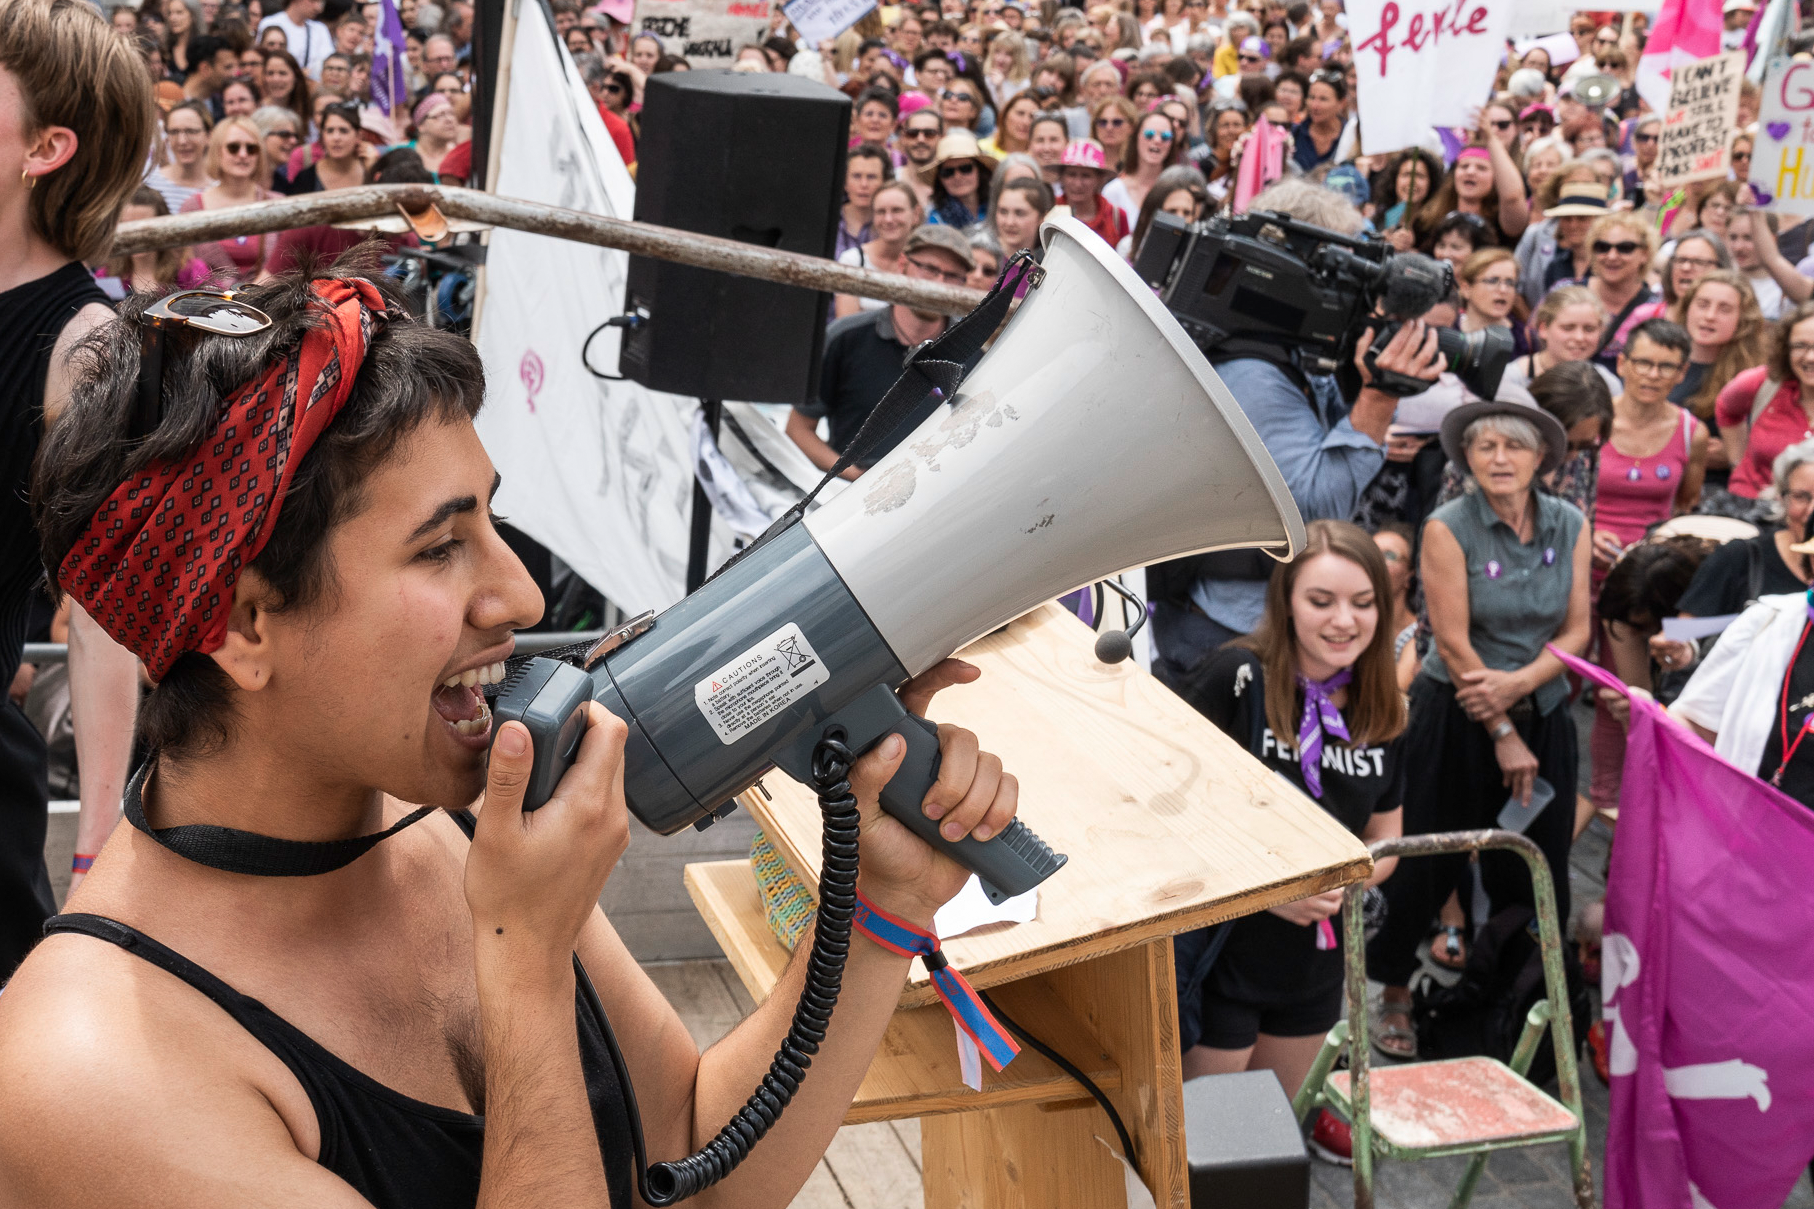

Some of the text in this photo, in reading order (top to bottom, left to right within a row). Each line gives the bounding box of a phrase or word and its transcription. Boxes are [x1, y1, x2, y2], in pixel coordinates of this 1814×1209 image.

[1670, 74, 1734, 108] BELIEVE
[1672, 69, 1679, 86] I
[1660, 127, 1728, 167] PROTEST
[1662, 122, 1700, 143] HAVE
[718, 683, 734, 696] correct
[732, 674, 748, 687] polarity
[748, 666, 760, 676] when
[758, 655, 777, 669] inserting
[721, 654, 763, 684] CAUTIONS
[713, 700, 728, 712] Speak
[727, 695, 738, 703] with
[753, 675, 766, 685] voice
[765, 665, 781, 678] through
[722, 714, 736, 725] Never
[735, 709, 745, 717] use
[751, 689, 775, 707] megaphone
[773, 678, 790, 692] pointed
[724, 694, 748, 712] microphone
[746, 679, 770, 697] mouthpiece
[768, 672, 781, 682] bring
[720, 710, 733, 721] close
[736, 701, 747, 710] your
[726, 717, 741, 729] directly
[728, 720, 748, 734] Remove
[752, 703, 772, 718] batteries
[771, 695, 783, 705] when
[782, 690, 791, 698] not
[743, 715, 763, 730] MADE
[768, 697, 792, 714] KOREA
[1262, 728, 1385, 777] FENIST
